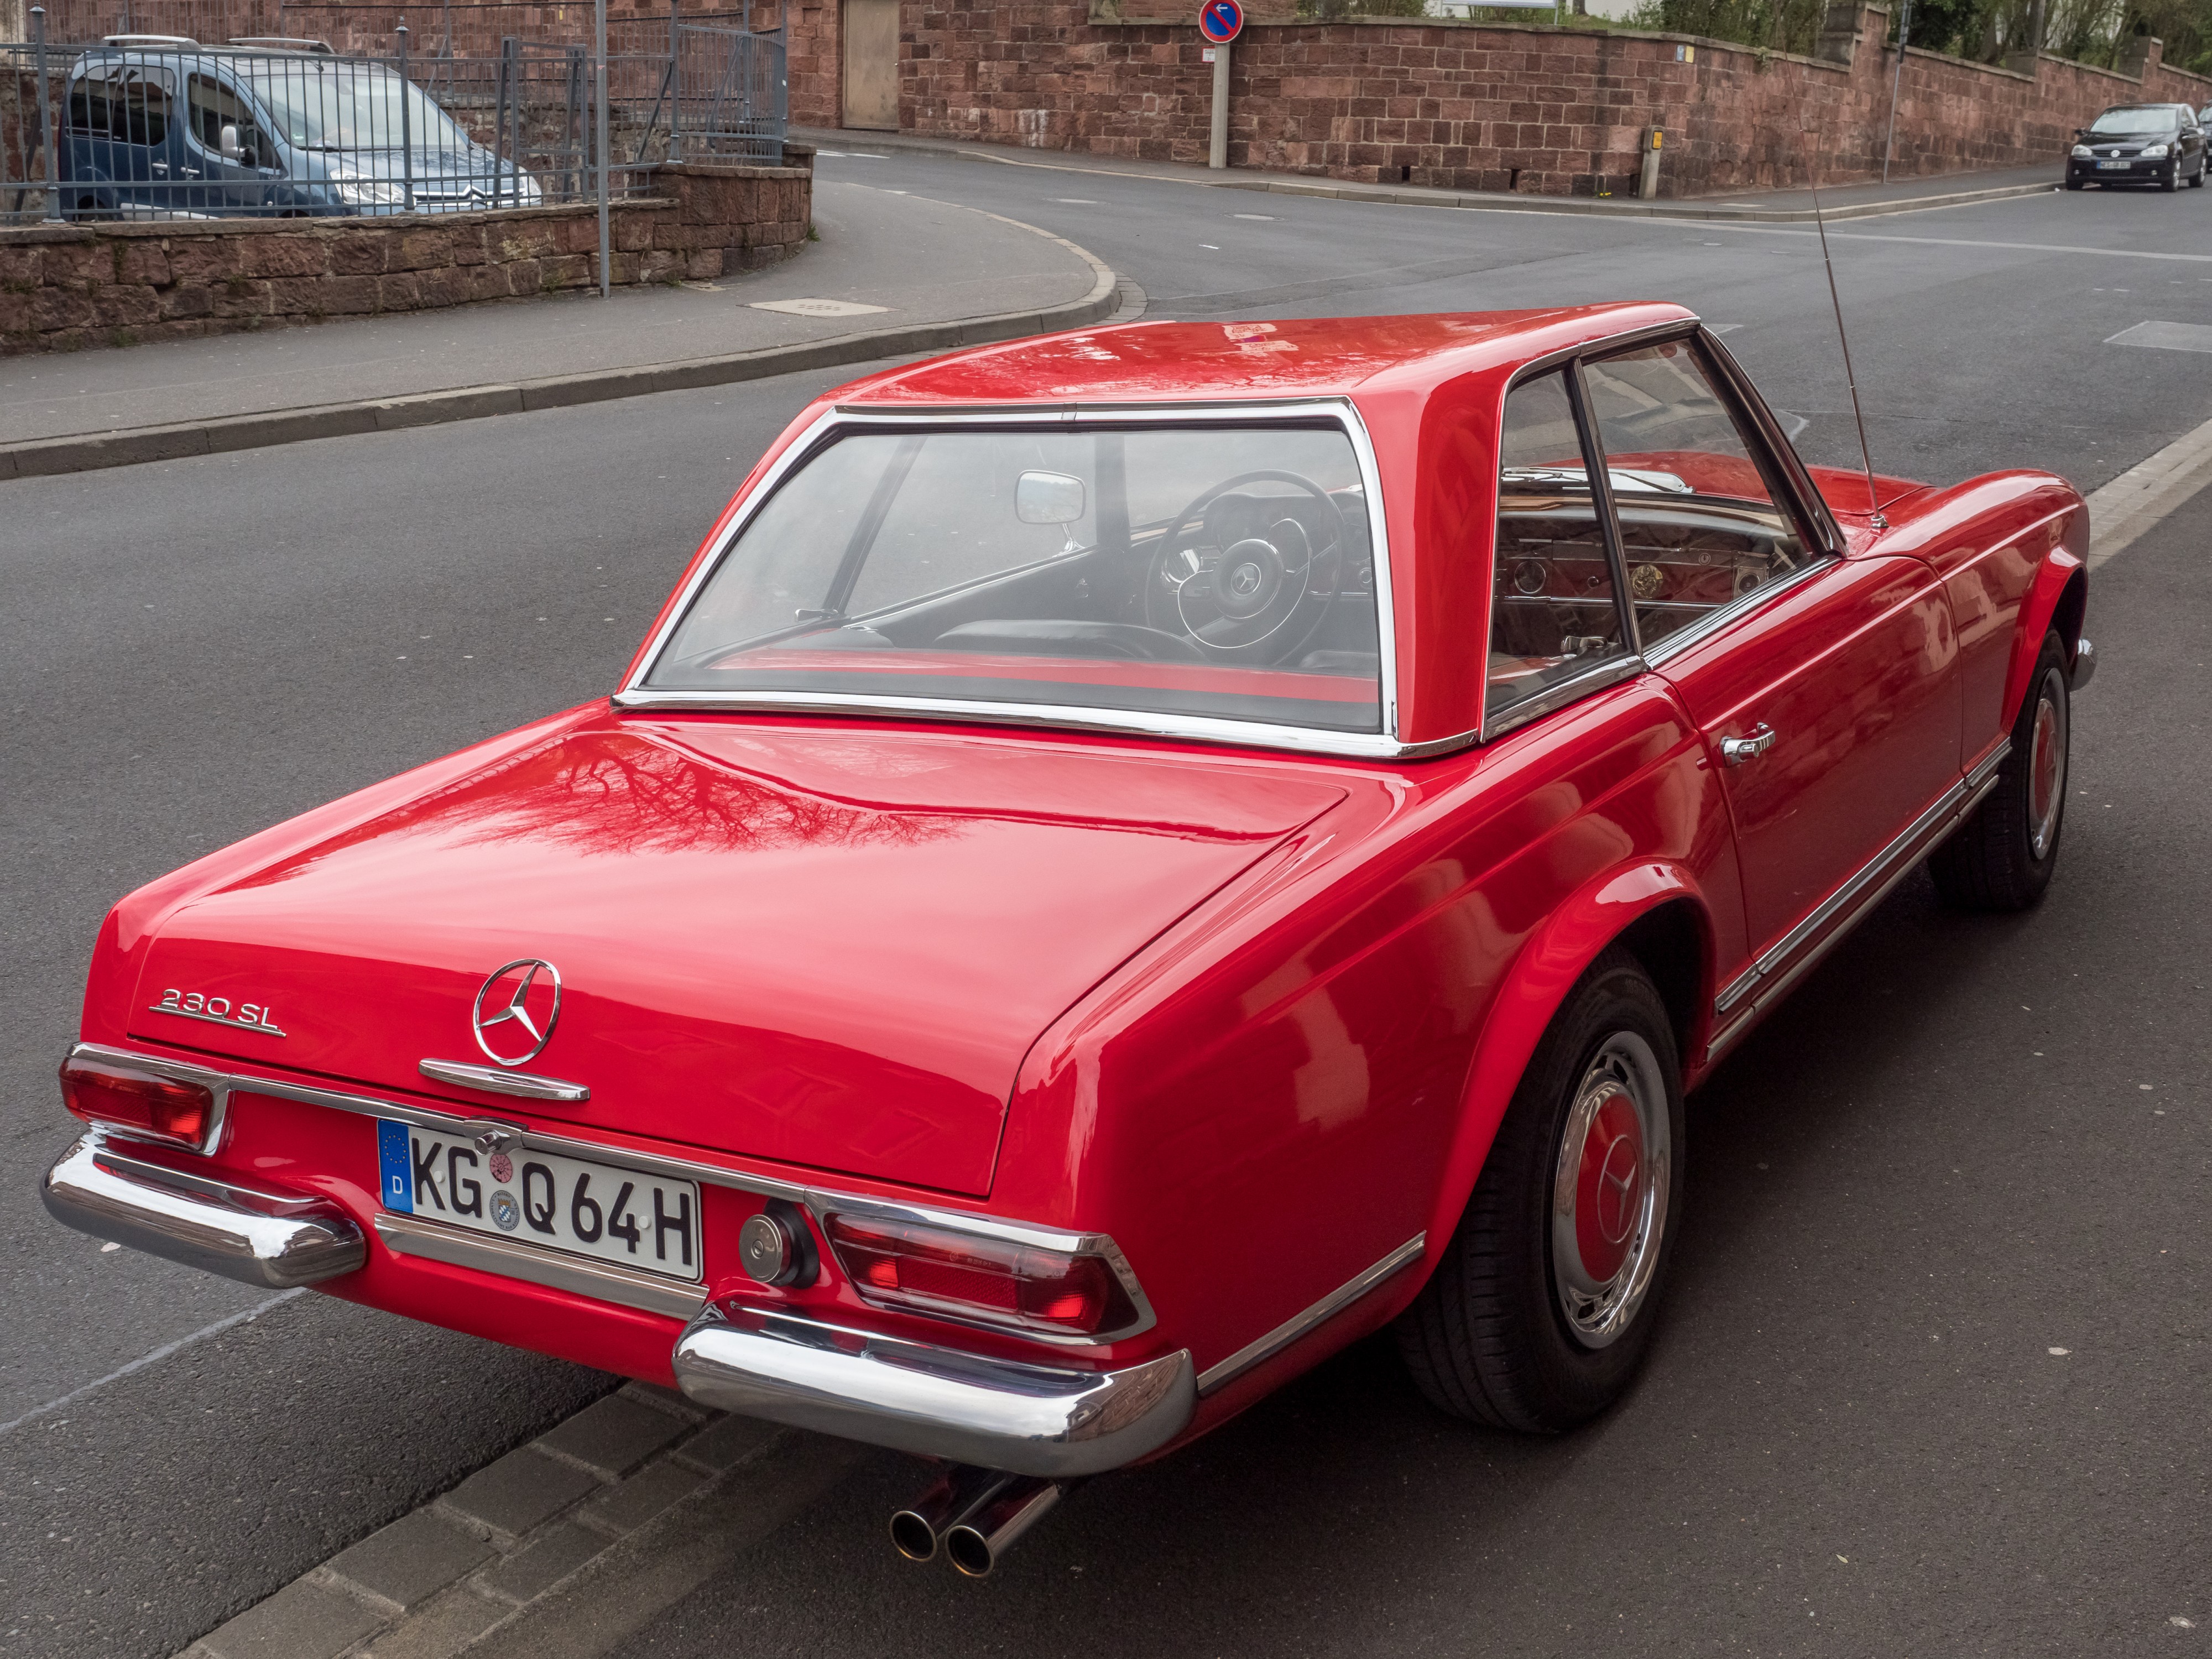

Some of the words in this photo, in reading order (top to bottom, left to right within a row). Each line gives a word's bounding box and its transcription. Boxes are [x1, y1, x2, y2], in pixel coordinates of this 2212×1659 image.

[162, 988, 231, 1016] 230
[237, 1004, 278, 1030] SL
[392, 1175, 403, 1194] D
[411, 1138, 483, 1218] KG
[521, 1161, 556, 1235] Q
[571, 1172, 692, 1266] 64H
